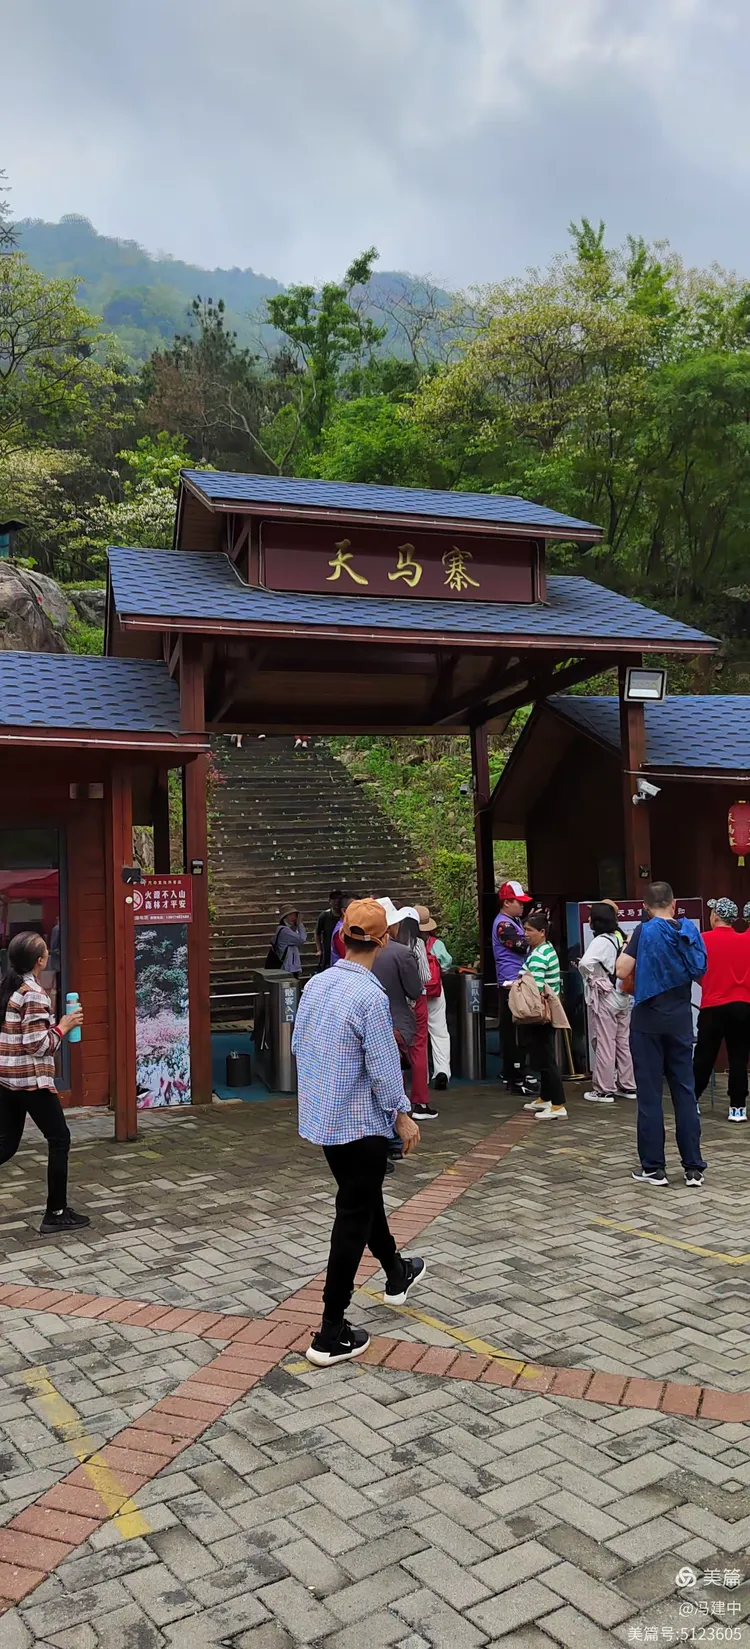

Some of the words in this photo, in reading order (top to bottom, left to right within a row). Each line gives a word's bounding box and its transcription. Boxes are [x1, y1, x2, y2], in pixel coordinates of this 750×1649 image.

[326, 538, 480, 592] 天马寨
[144, 890, 186, 899] 火源不入山
[144, 900, 186, 909] 森林才平安
[284, 988, 295, 1022] 散客入口
[470, 980, 481, 1012] 团队入口
